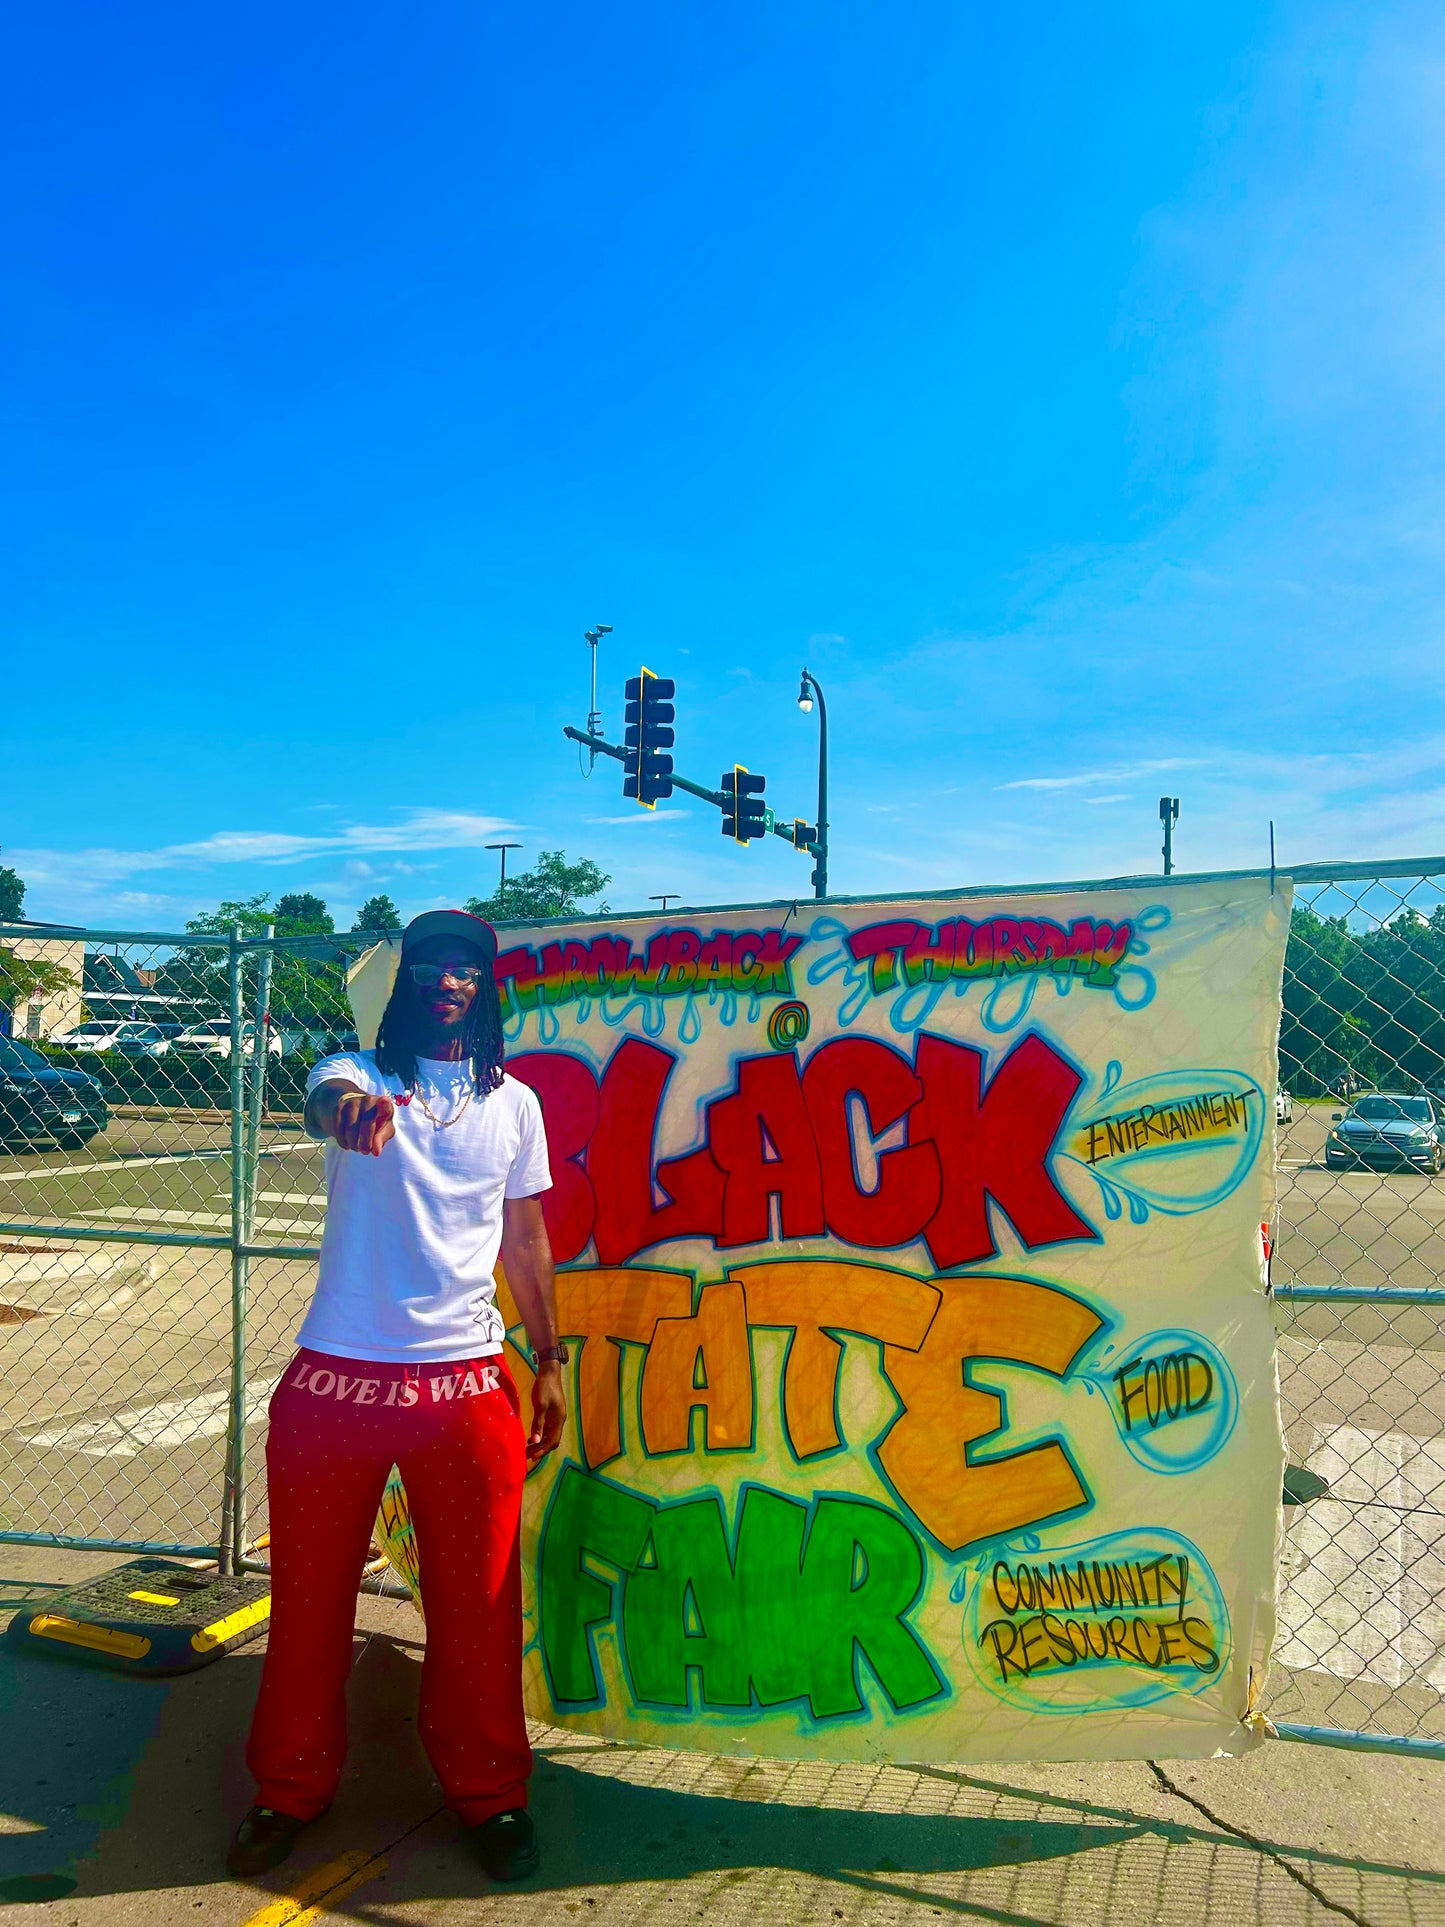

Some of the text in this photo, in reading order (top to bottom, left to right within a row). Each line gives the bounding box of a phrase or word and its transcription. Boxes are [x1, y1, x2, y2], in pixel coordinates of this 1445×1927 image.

[494, 917, 1131, 1022] THROWBACK THURSDAY
[768, 1001, 811, 1050] @
[1083, 1088, 1257, 1166] ENTERTAINMENT
[291, 1363, 500, 1407] LOVE IS WAR
[1112, 1352, 1213, 1431] FOOD
[541, 1466, 945, 1718] FAIR
[992, 1553, 1189, 1620] COMMUNITY
[976, 1611, 1220, 1683] RESOURCES
